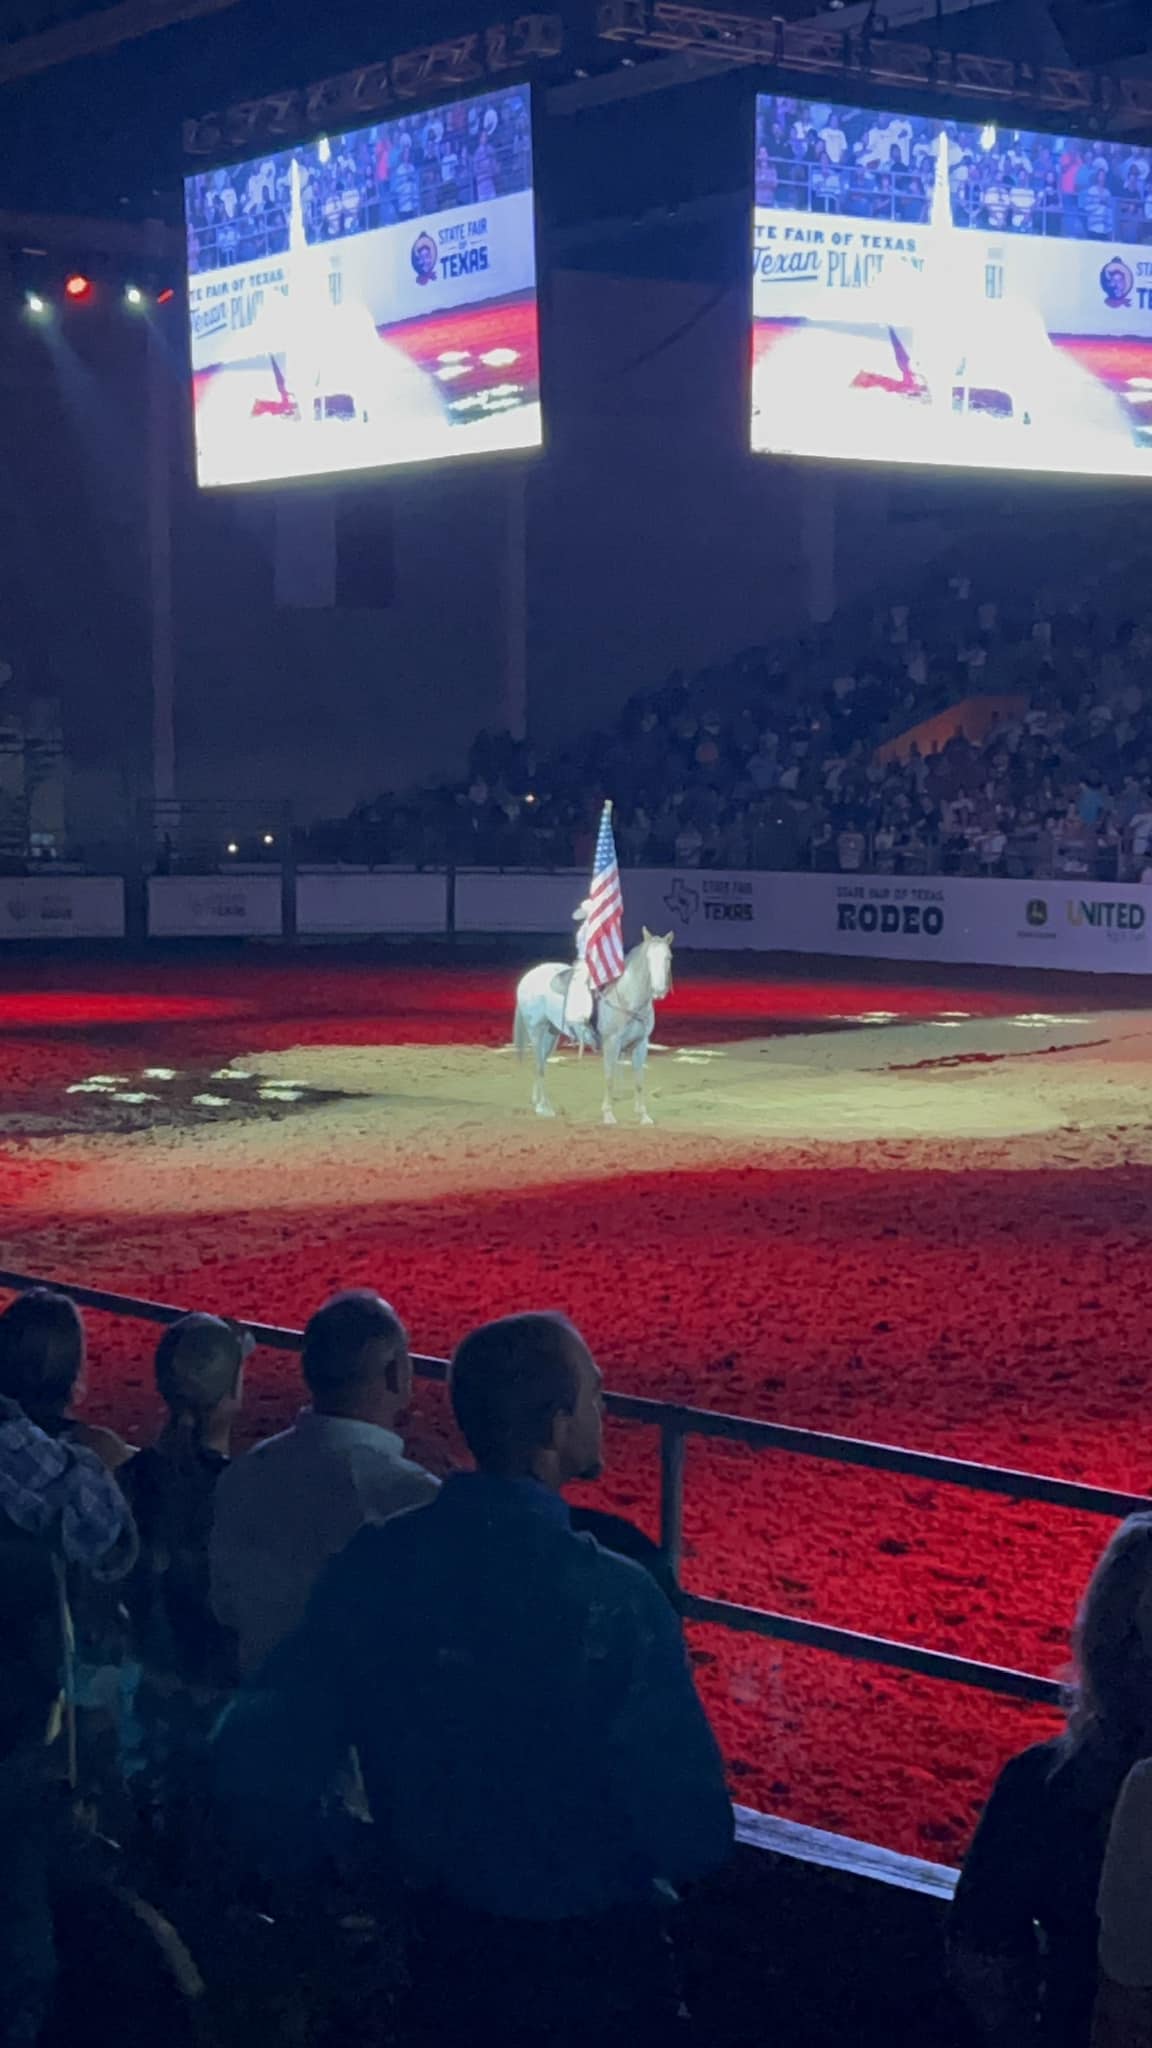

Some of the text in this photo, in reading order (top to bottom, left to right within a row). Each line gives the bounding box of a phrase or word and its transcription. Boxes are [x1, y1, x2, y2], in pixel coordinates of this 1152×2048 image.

[438, 217, 487, 245] STATE FAIR
[784, 227, 825, 244] FAIR
[831, 231, 853, 246] OF
[861, 235, 917, 252] TEXAS
[440, 246, 489, 279] TEXAS
[752, 246, 822, 275] Texan
[826, 249, 885, 288] PLAC
[206, 281, 229, 298] FAIR
[232, 277, 246, 292] OF
[249, 268, 284, 287] TEXAS
[703, 902, 754, 921] TEXAS
[837, 903, 944, 935] RODEO
[1065, 899, 1145, 930] UNITED
